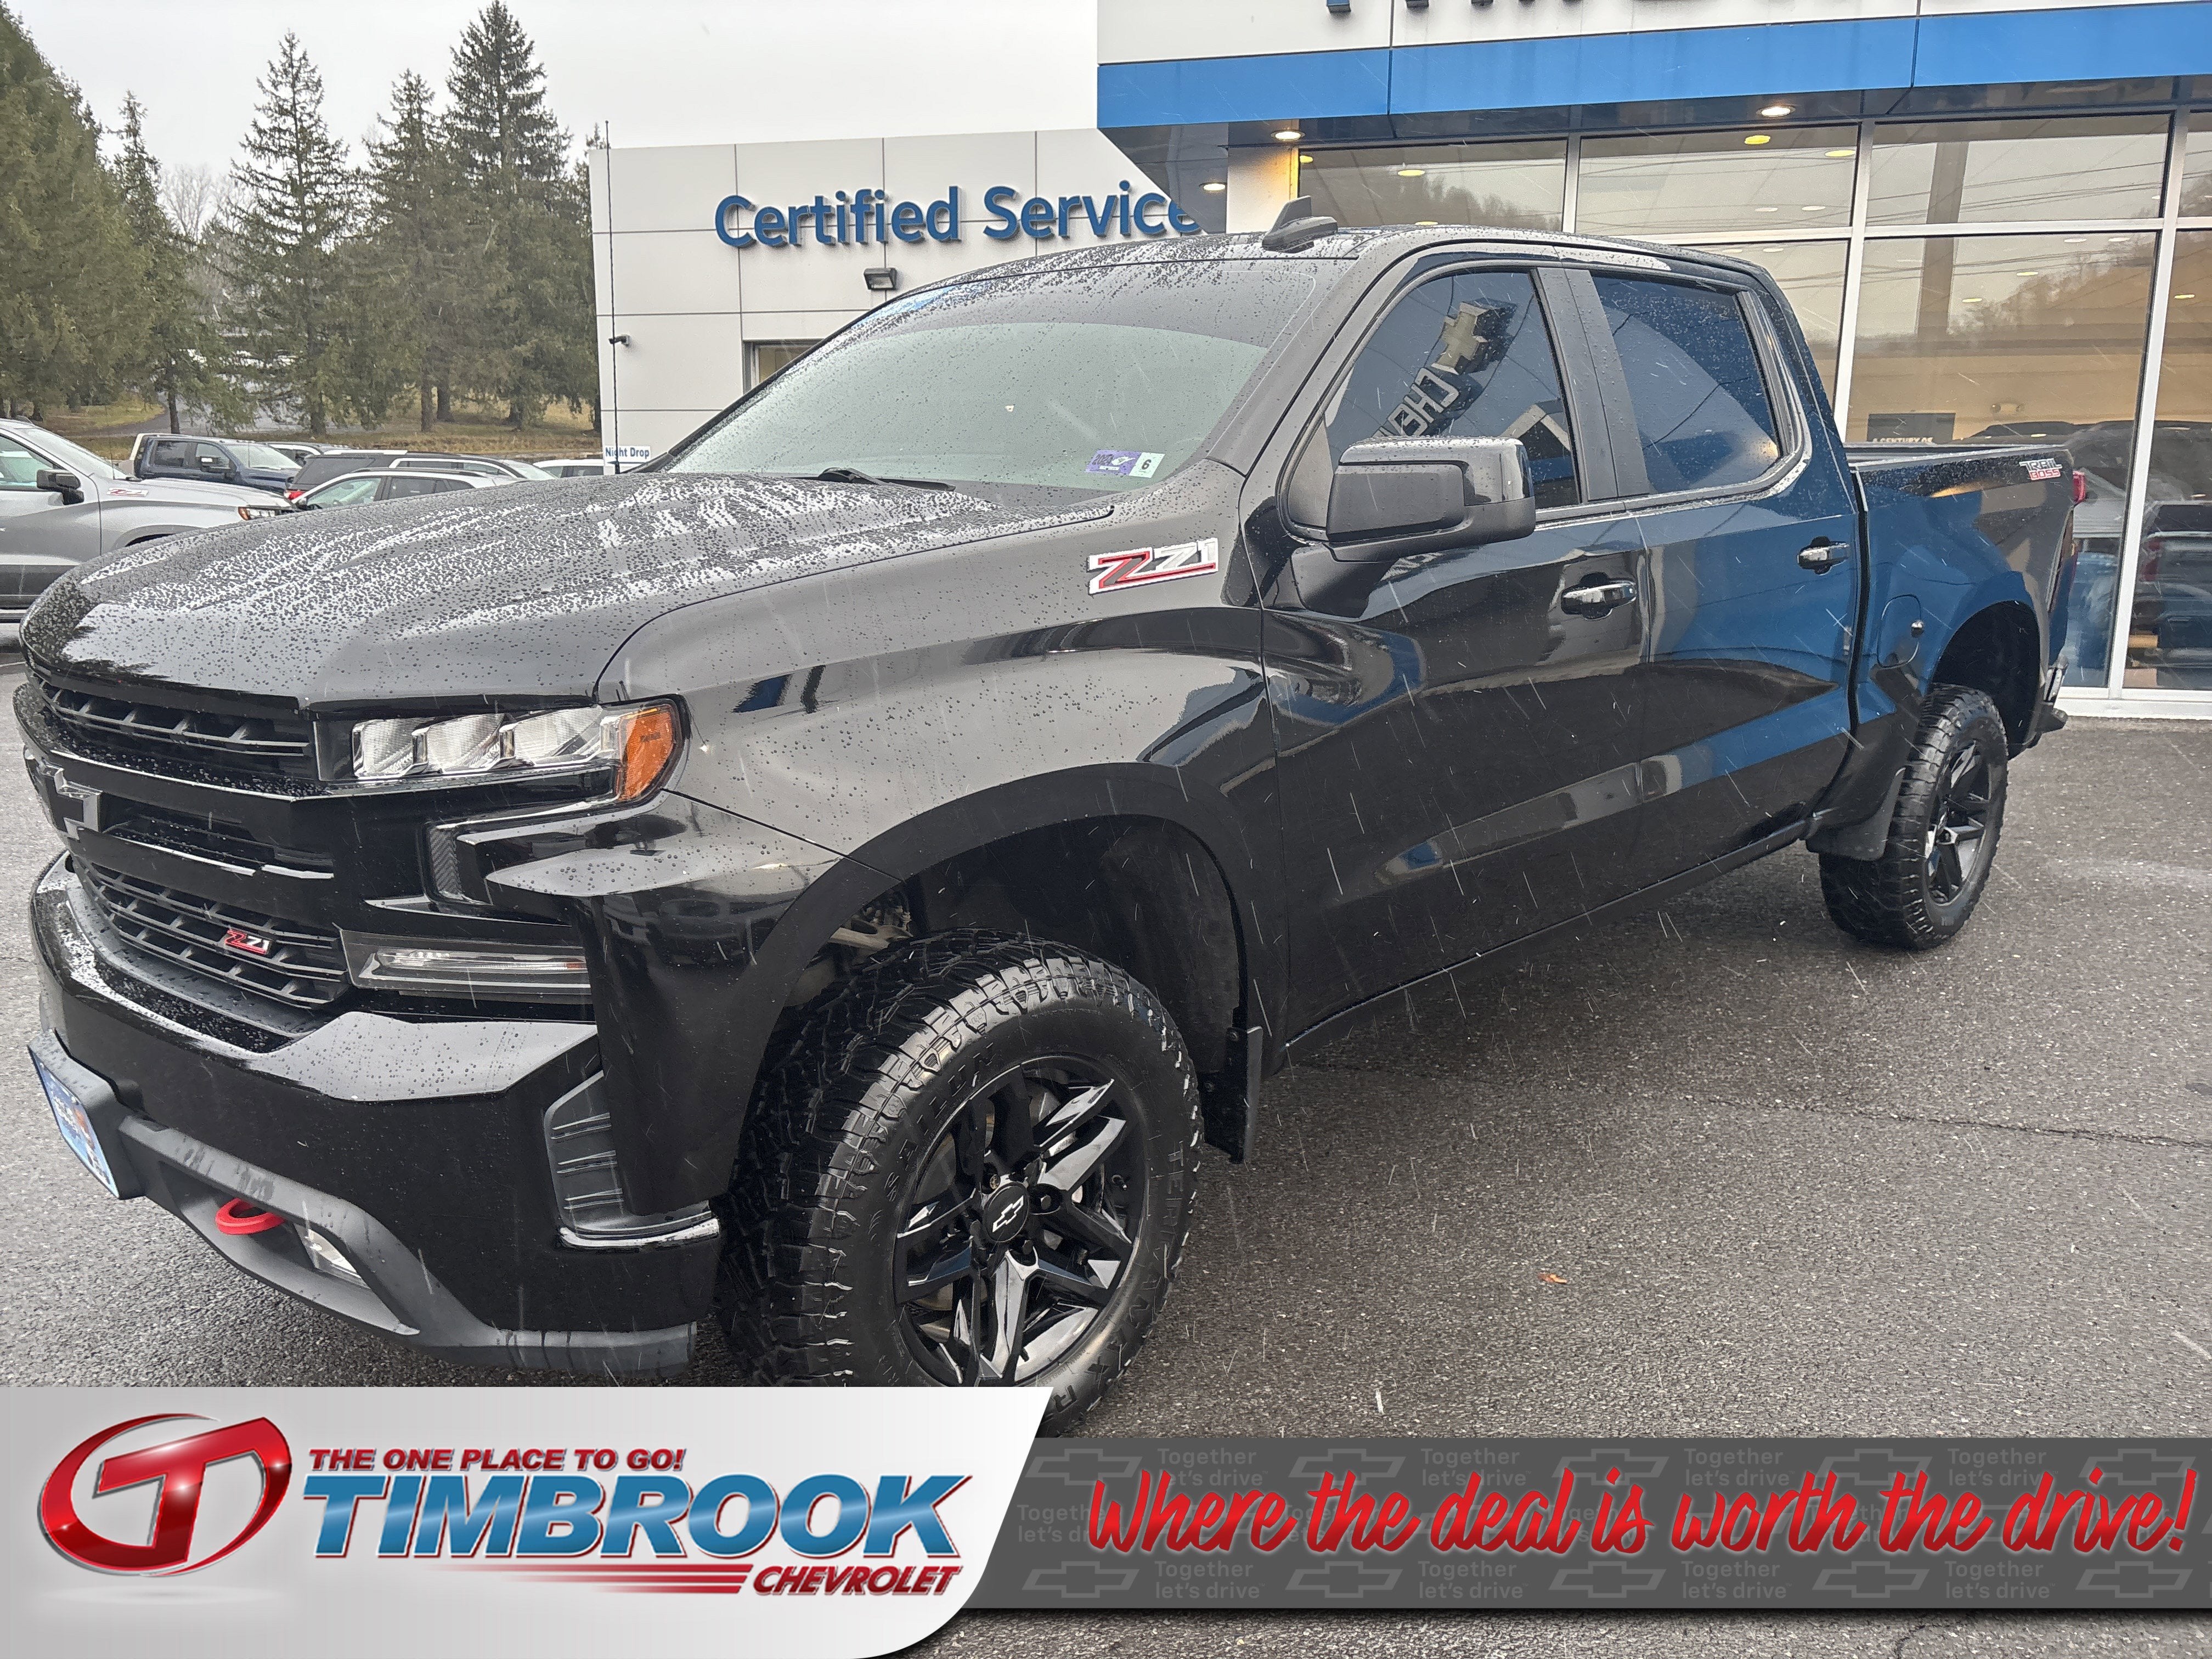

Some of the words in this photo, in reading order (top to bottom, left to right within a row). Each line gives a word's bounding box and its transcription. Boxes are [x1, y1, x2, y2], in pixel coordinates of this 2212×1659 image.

[715, 185, 962, 247] Certified
[630, 447, 650, 459] Drop
[1141, 459, 1152, 470] 6
[2019, 458, 2063, 471] TRAIL
[2029, 469, 2061, 481] BOSS
[1086, 538, 1219, 595] Z71
[224, 929, 272, 955] Z71
